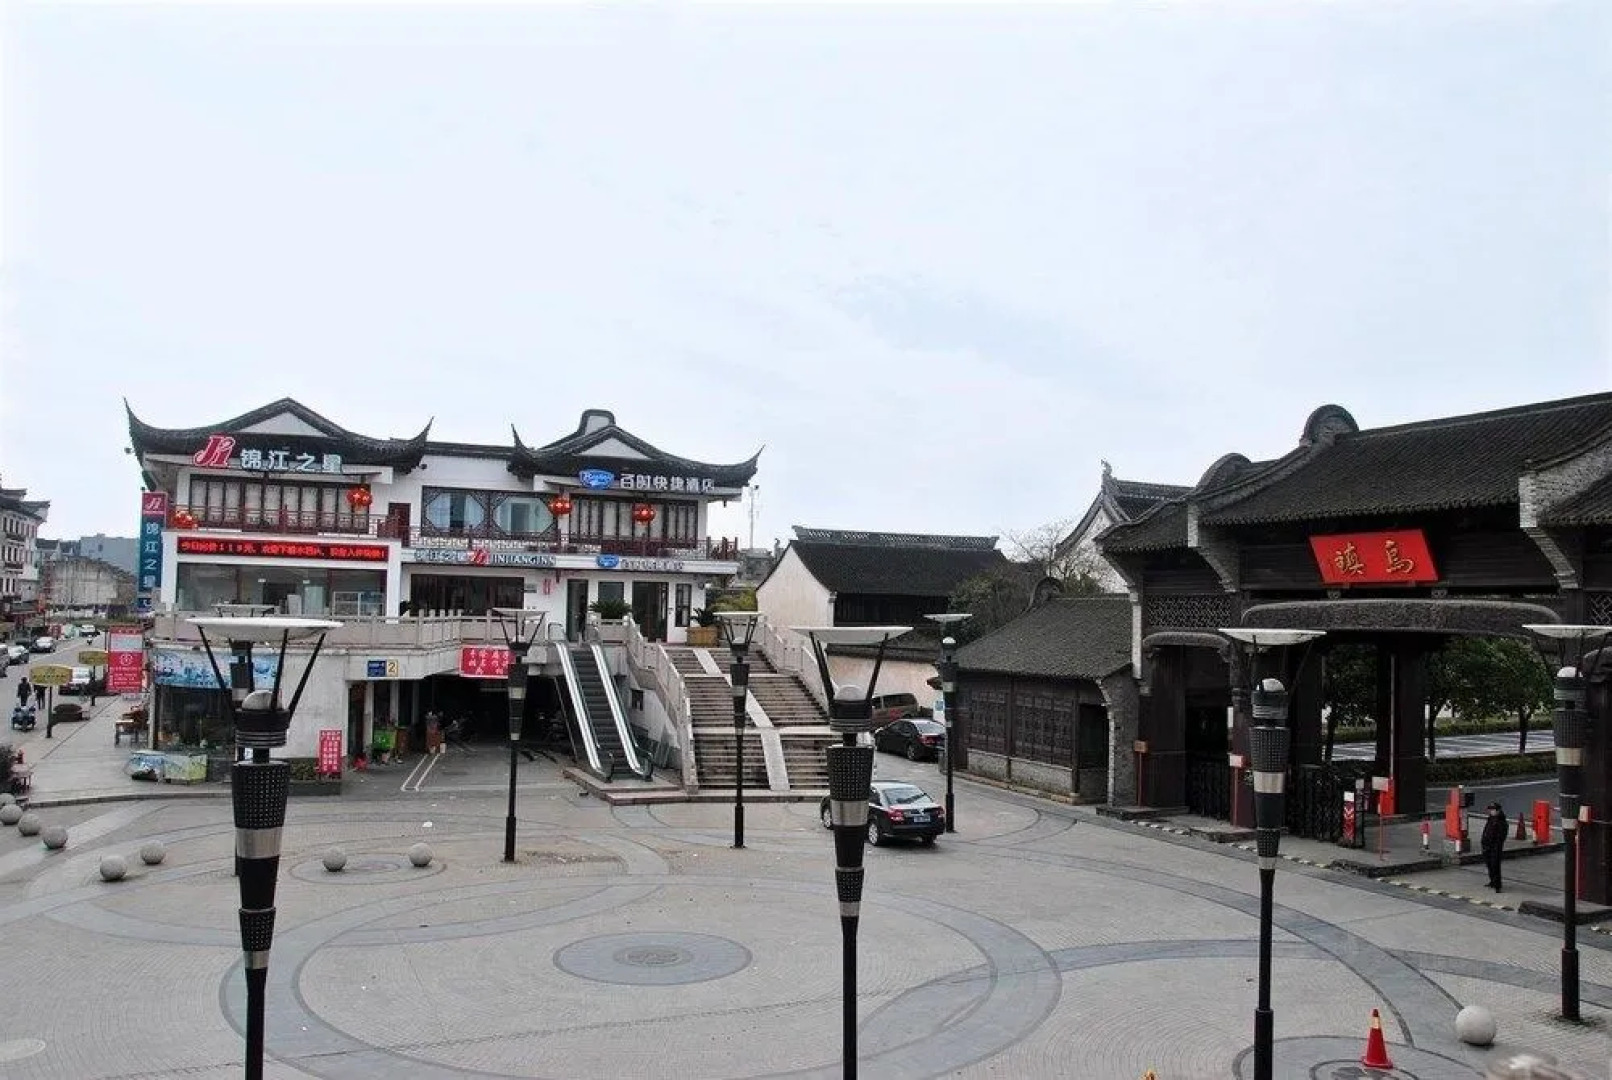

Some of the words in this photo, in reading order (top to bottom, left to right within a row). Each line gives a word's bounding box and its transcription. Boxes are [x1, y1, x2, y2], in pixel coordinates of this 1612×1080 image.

[240, 449, 341, 473] 锦江之星
[620, 473, 715, 492] 百时快捷酒店
[388, 662, 396, 673] 2
